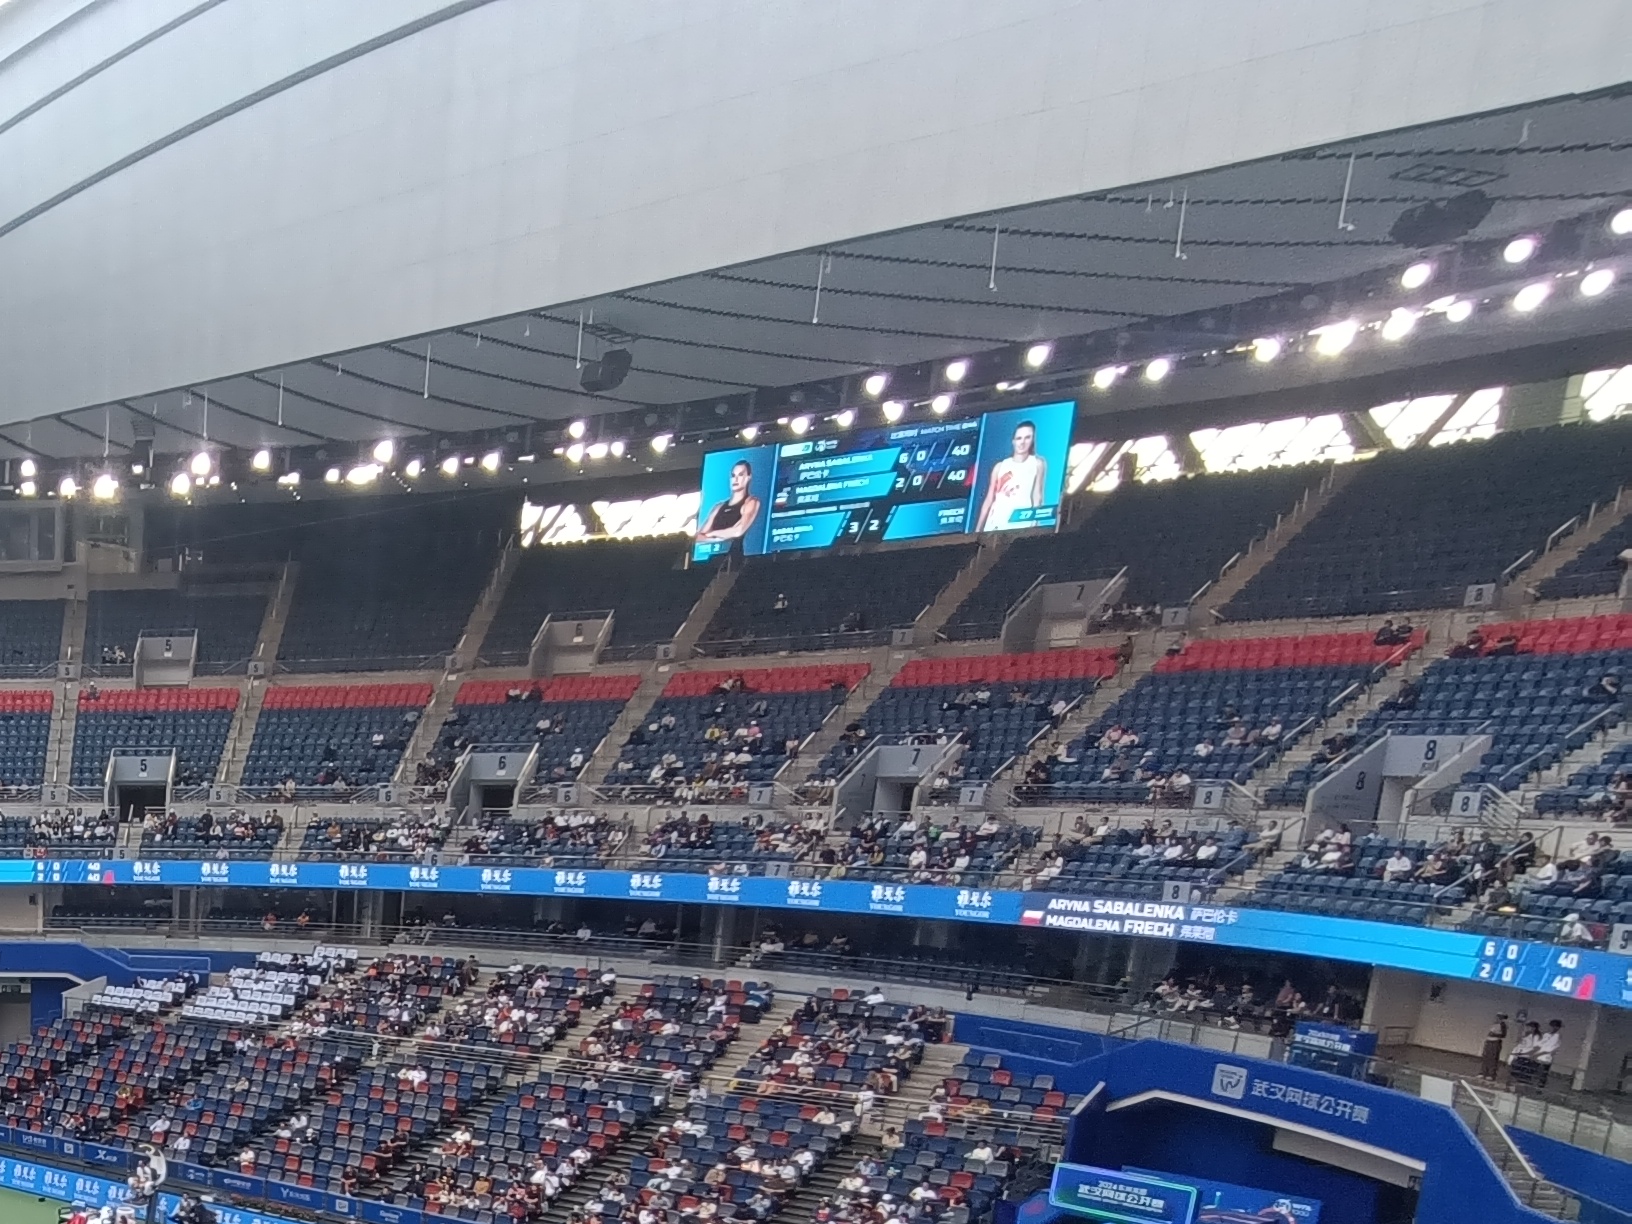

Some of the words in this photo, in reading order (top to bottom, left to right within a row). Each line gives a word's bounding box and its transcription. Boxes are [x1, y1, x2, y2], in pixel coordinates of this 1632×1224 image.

[899, 453, 908, 463] 6
[917, 451, 926, 461] 0
[952, 444, 970, 455] 40
[896, 478, 905, 488] 2
[913, 475, 922, 486] 0
[947, 470, 965, 481] 40
[849, 523, 859, 533] 3
[870, 520, 879, 530] 2
[1077, 584, 1085, 600] 7
[165, 639, 171, 651] 5
[912, 748, 921, 765] 7
[1425, 740, 1436, 760] 8
[141, 759, 147, 772] 5
[499, 756, 506, 770] 6
[51, 791, 55, 800] 5
[216, 791, 221, 800] 5
[385, 791, 391, 802] 6
[564, 791, 571, 802] 6
[757, 790, 763, 801] 7
[969, 790, 975, 802] 7
[1204, 791, 1212, 804] 8
[1461, 796, 1470, 812] 8
[120, 850, 125, 859] 5
[431, 854, 437, 866] 6
[774, 864, 781, 876] 7
[1172, 885, 1180, 899] 8
[1048, 899, 1090, 914] ARYNA
[1094, 900, 1184, 920] SABALENKA
[1046, 915, 1120, 933] MAGDALENA
[1124, 920, 1174, 937] FRECH
[1484, 942, 1495, 957] 6
[1506, 945, 1520, 961] 0
[1558, 952, 1578, 969] 40
[1479, 963, 1492, 978] 2
[1501, 966, 1514, 981] 0
[1552, 976, 1573, 992] 40
[1252, 1079, 1370, 1124] 武汉网球公开赛
[1078, 1184, 1164, 1209] 武汉网球公开赛
